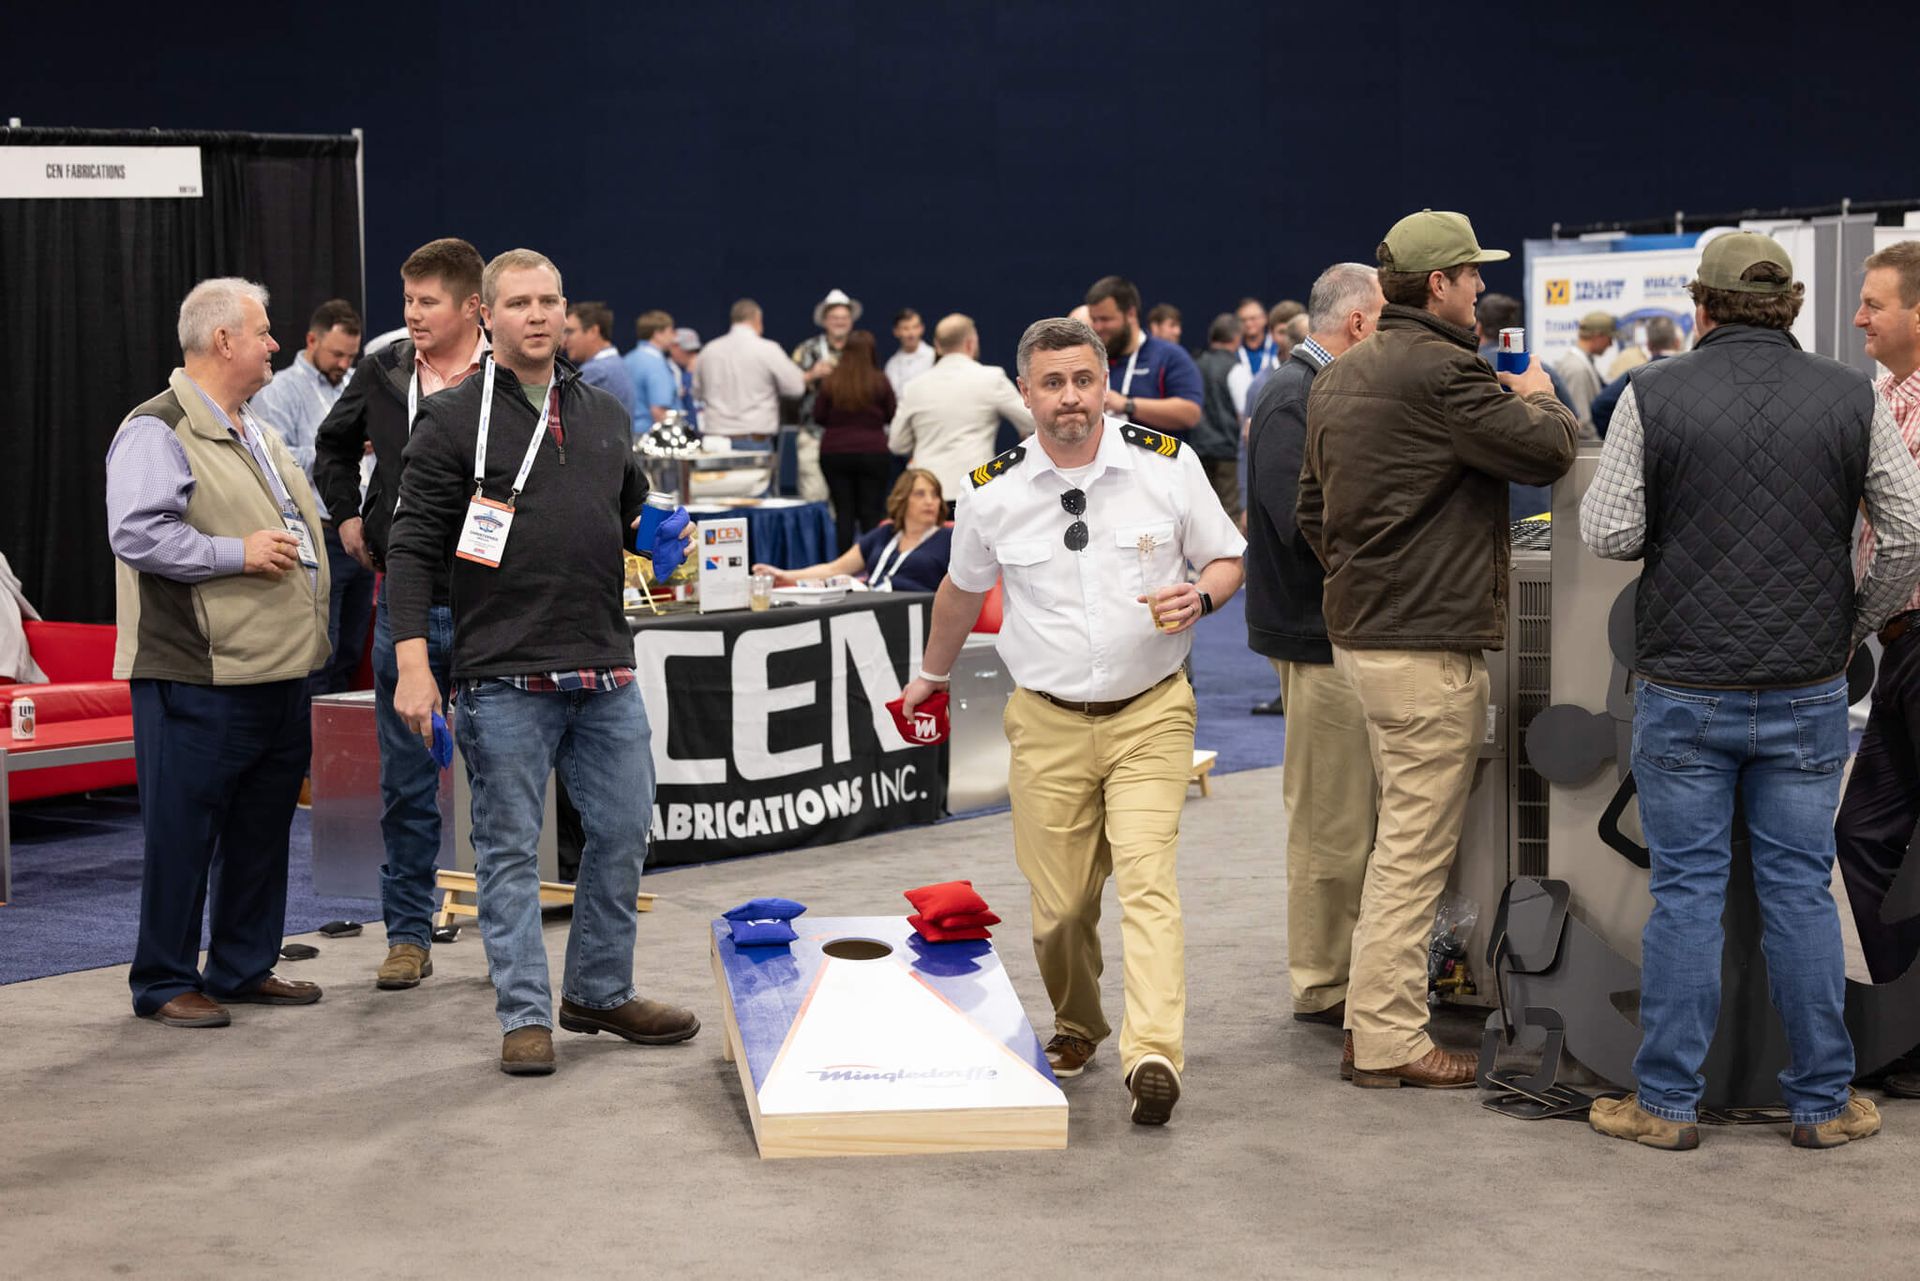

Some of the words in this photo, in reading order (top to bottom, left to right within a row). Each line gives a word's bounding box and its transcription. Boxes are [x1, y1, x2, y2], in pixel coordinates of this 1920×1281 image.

[46, 163, 63, 178] CEN
[66, 164, 126, 179] FABRICATIONS
[717, 527, 743, 539] CEN
[634, 604, 926, 785] CEN
[647, 776, 862, 842] ABRICATIONS
[871, 764, 928, 808] INC.
